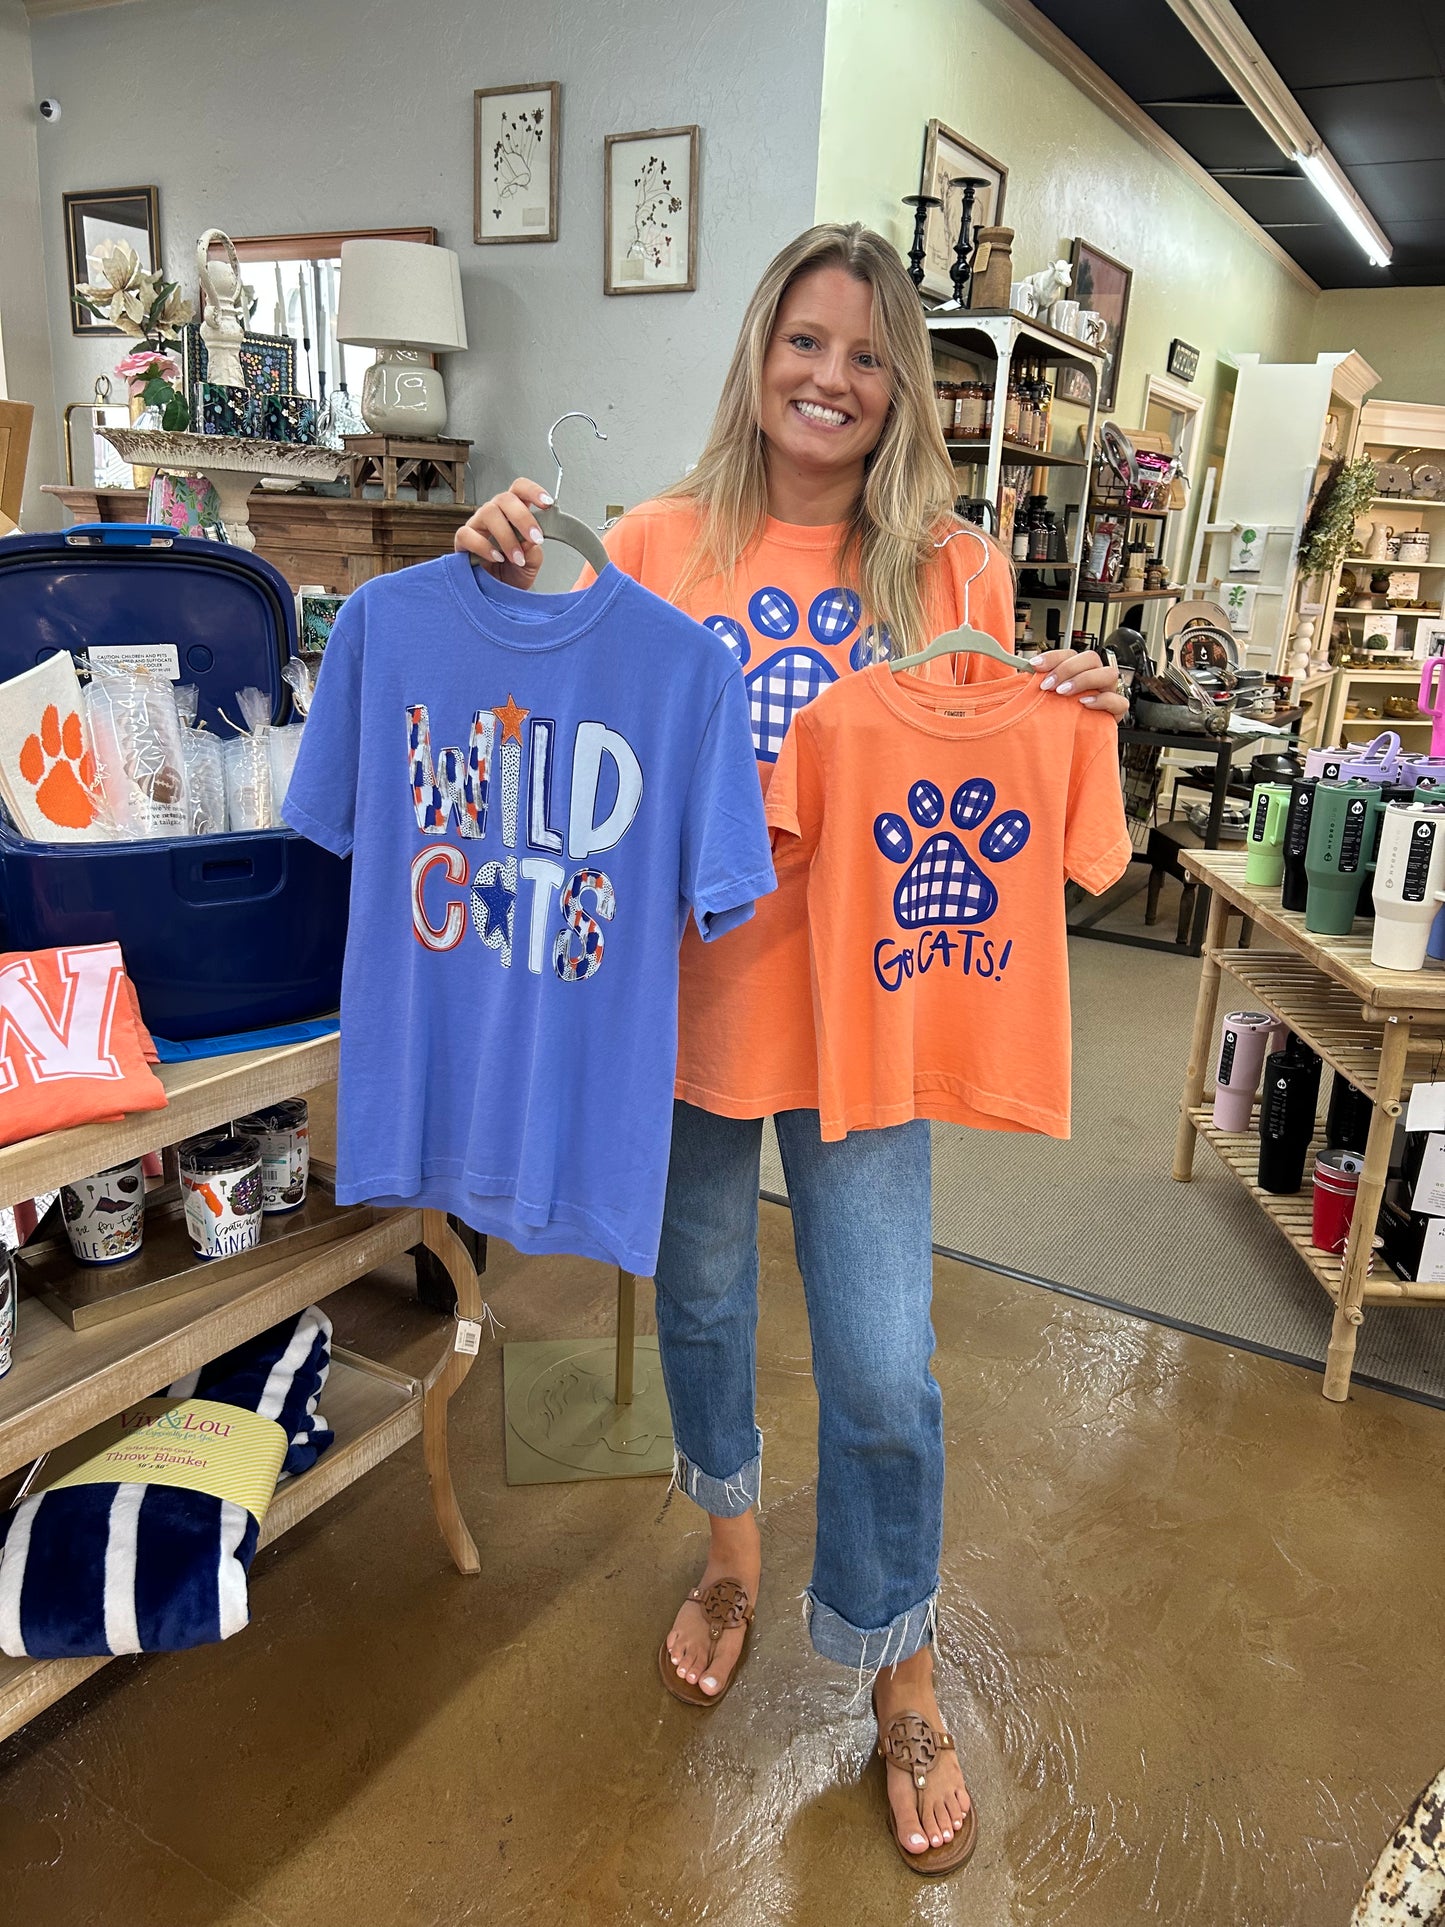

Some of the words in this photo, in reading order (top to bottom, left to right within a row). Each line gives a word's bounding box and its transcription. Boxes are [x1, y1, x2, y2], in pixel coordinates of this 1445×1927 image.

[874, 938, 914, 992] Go
[120, 1409, 231, 1437] Viv&Lou
[105, 1451, 149, 1461] Throw
[153, 1452, 208, 1468] Blanket
